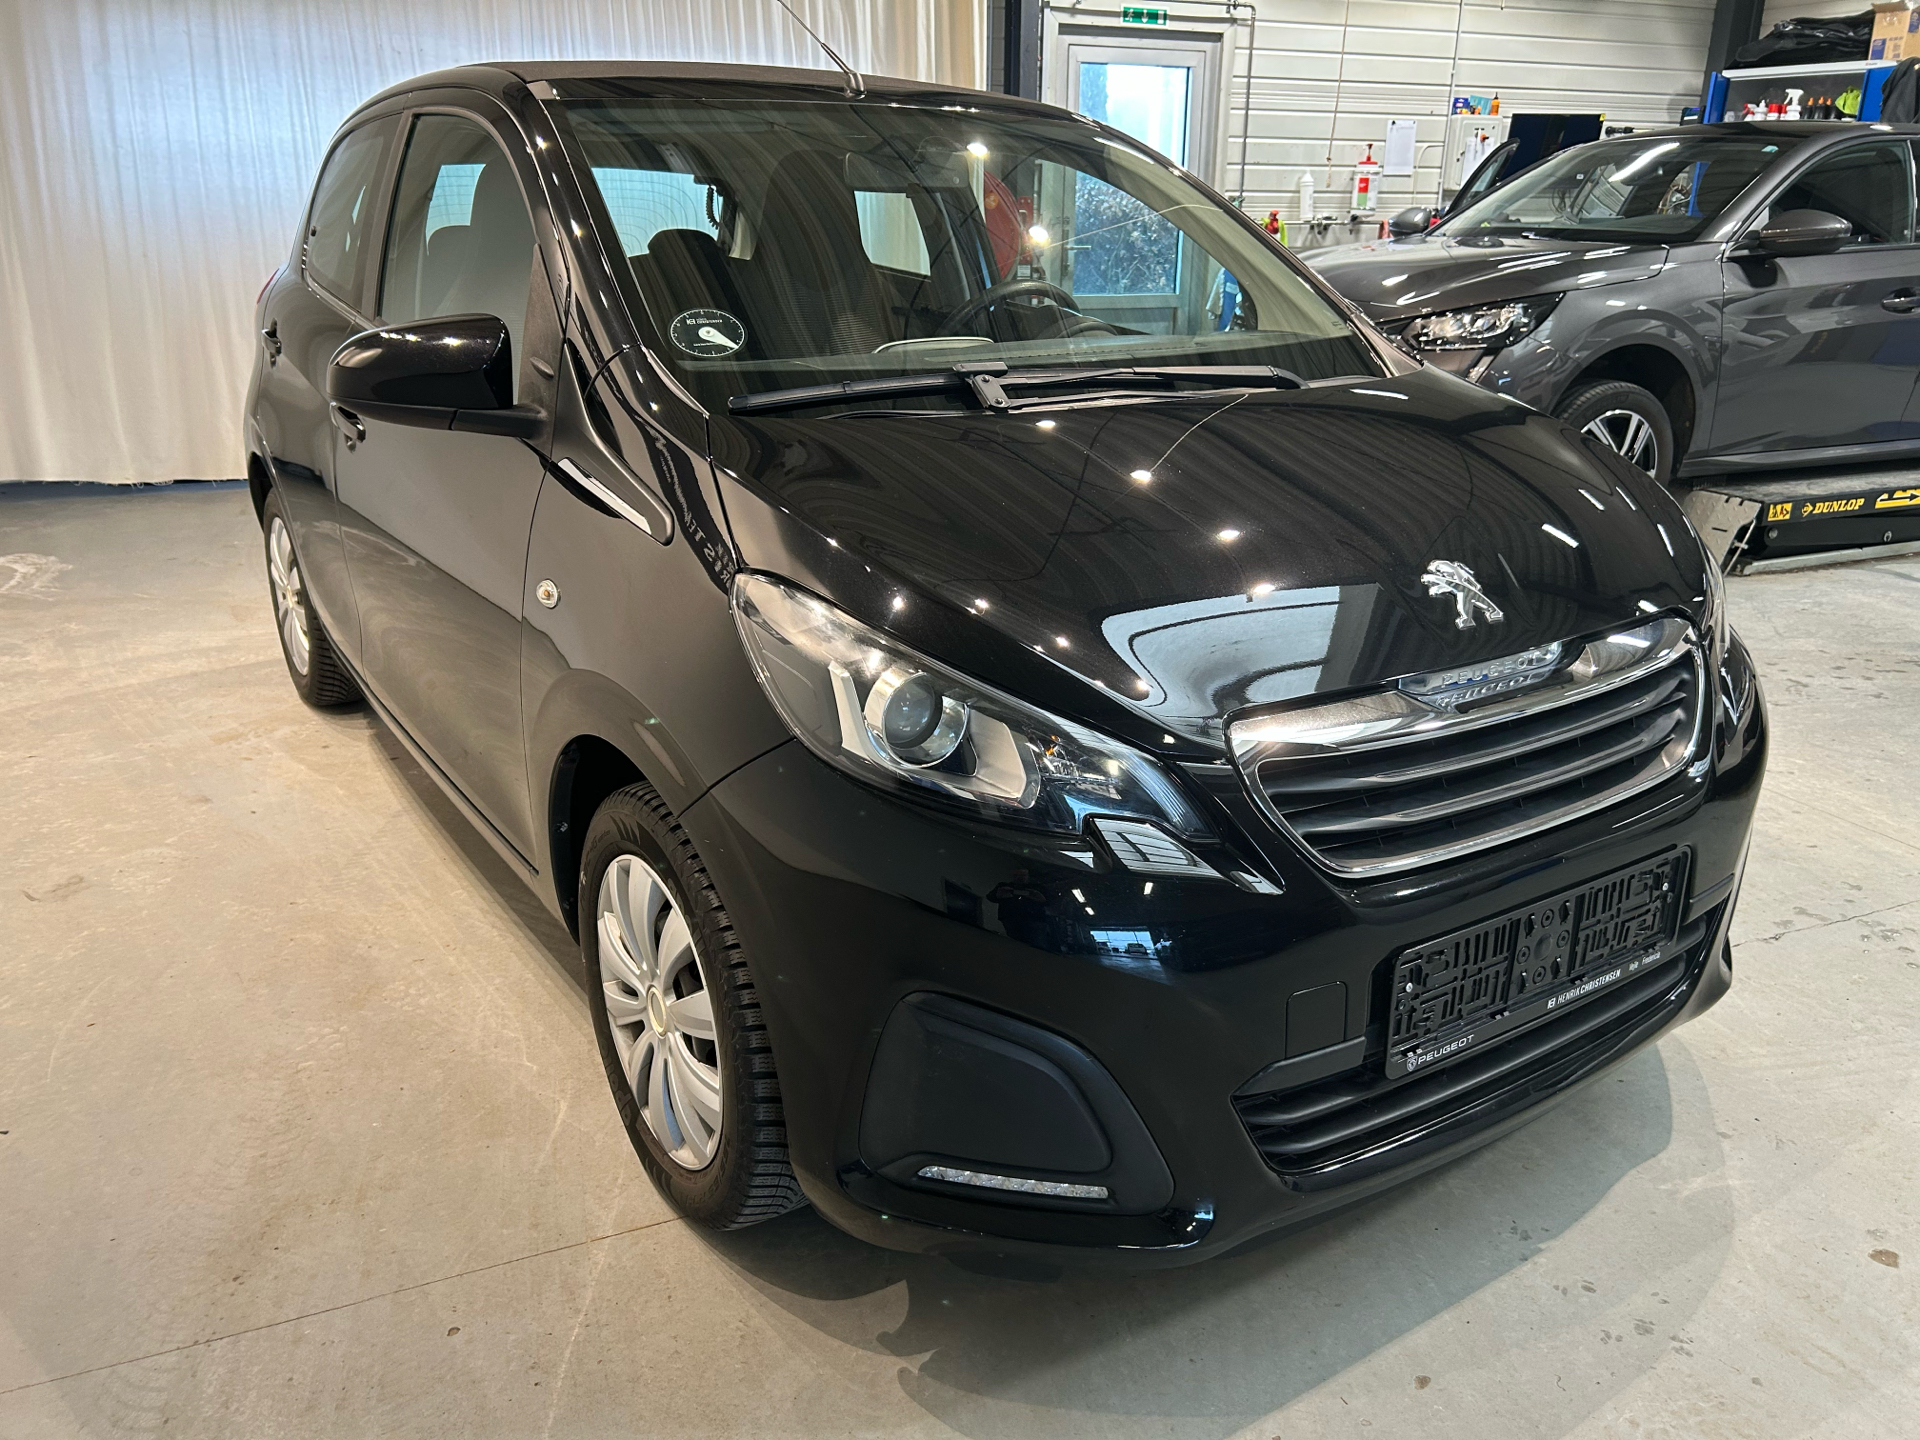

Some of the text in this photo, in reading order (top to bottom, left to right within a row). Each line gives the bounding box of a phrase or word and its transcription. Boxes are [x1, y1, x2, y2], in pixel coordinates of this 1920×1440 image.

[1812, 498, 1865, 514] DUNLOP
[1441, 651, 1541, 688] PEUGEOT
[1557, 987, 1580, 1004] HENRIK
[1580, 968, 1621, 994] CHRISTENSEN
[1418, 1034, 1474, 1065] PEUGEOT
